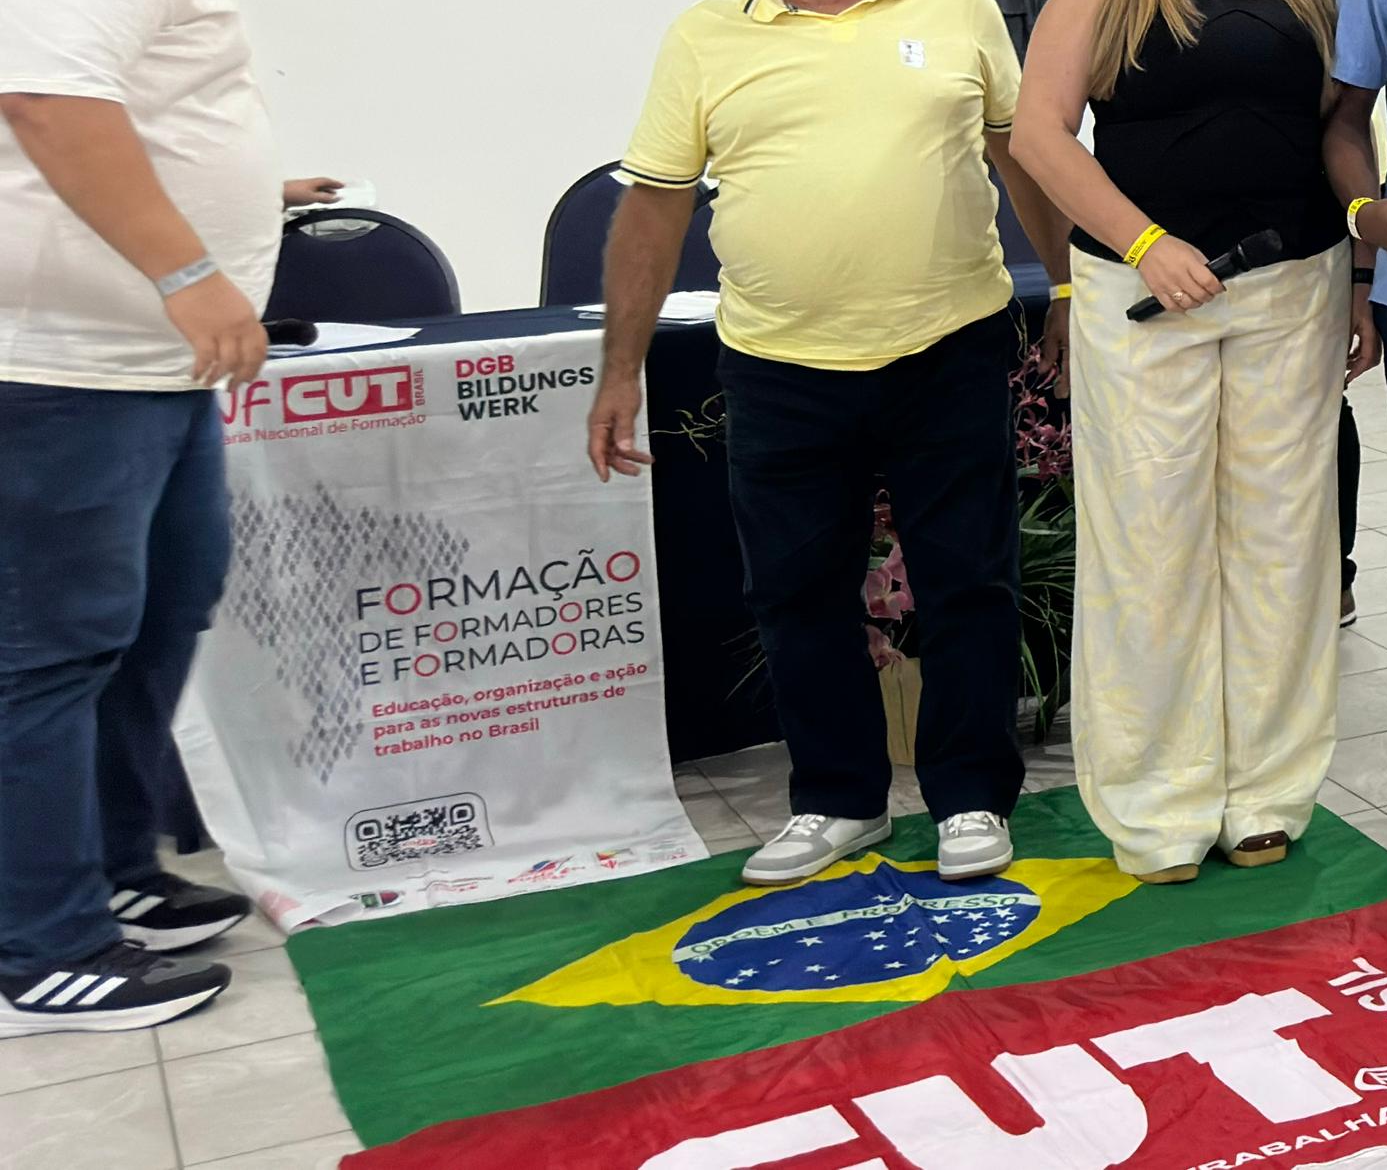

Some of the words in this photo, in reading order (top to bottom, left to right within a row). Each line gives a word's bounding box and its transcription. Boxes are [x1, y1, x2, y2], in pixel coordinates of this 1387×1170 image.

[414, 368, 426, 407] BRASIL
[455, 355, 515, 379] DGB
[457, 366, 595, 400] BILDUNGS
[286, 372, 408, 416] CUT
[458, 394, 540, 421] WERK
[255, 423, 324, 441] Nacional
[328, 422, 348, 434] de
[352, 414, 426, 431] Formação
[356, 548, 641, 620] FORMAÇÃO
[359, 628, 405, 654] DE
[415, 592, 643, 646] FORMADORES
[361, 661, 381, 686] E
[393, 621, 645, 680] FORMADORAS
[372, 692, 470, 718] Educação,
[474, 671, 586, 704] organização
[590, 670, 600, 682] e
[605, 663, 648, 683] ação
[374, 720, 415, 740] para
[420, 717, 440, 730] as
[446, 707, 500, 726] novas
[506, 690, 599, 716] estruturas
[603, 684, 626, 698] de
[374, 733, 454, 757] trabalho
[459, 729, 483, 743] no
[489, 717, 541, 738] Brasil
